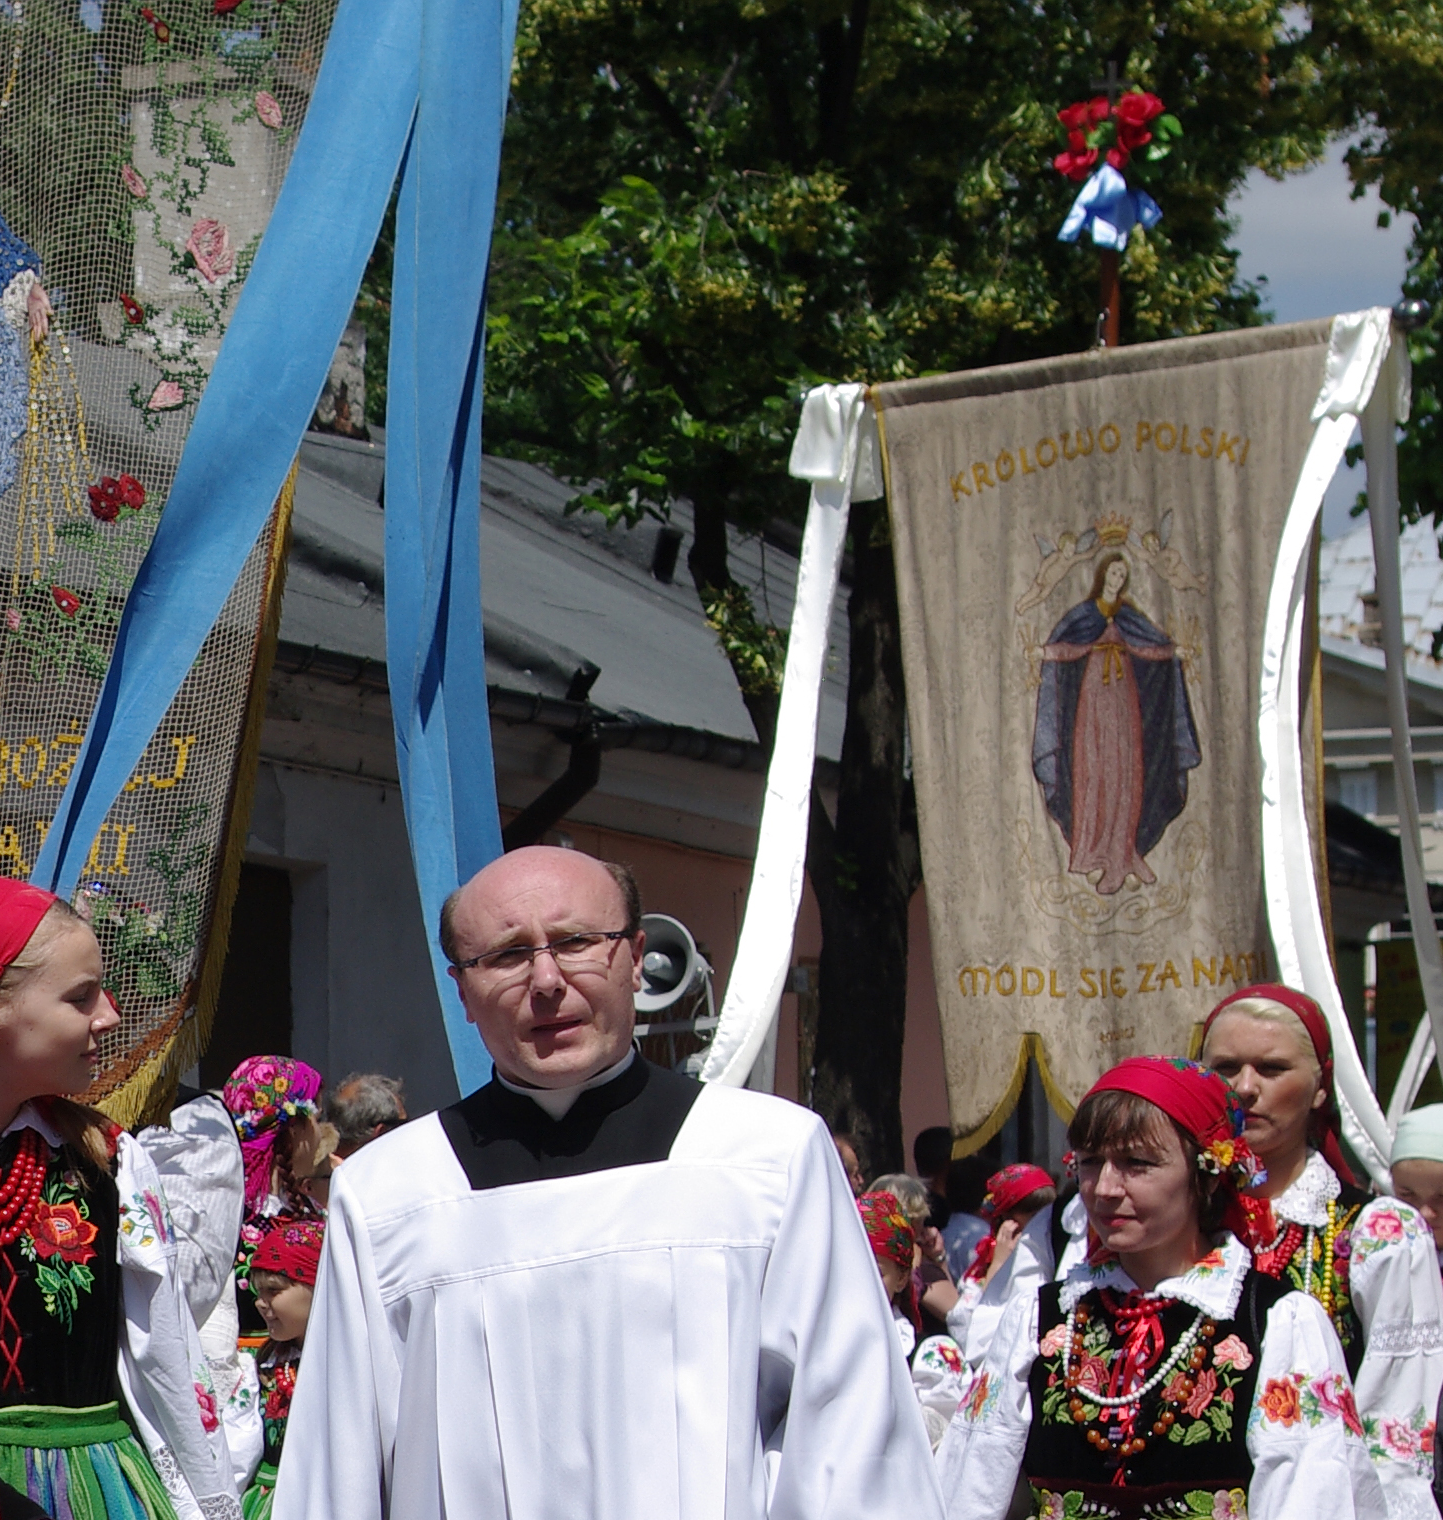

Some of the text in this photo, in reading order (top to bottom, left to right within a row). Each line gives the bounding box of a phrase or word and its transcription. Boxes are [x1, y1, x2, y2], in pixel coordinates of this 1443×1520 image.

[949, 420, 1251, 502] KRÓLOWO POLSKI
[958, 963, 1066, 998] MÓDL
[1137, 960, 1182, 993] ZA
[1192, 950, 1266, 989] NAMI
